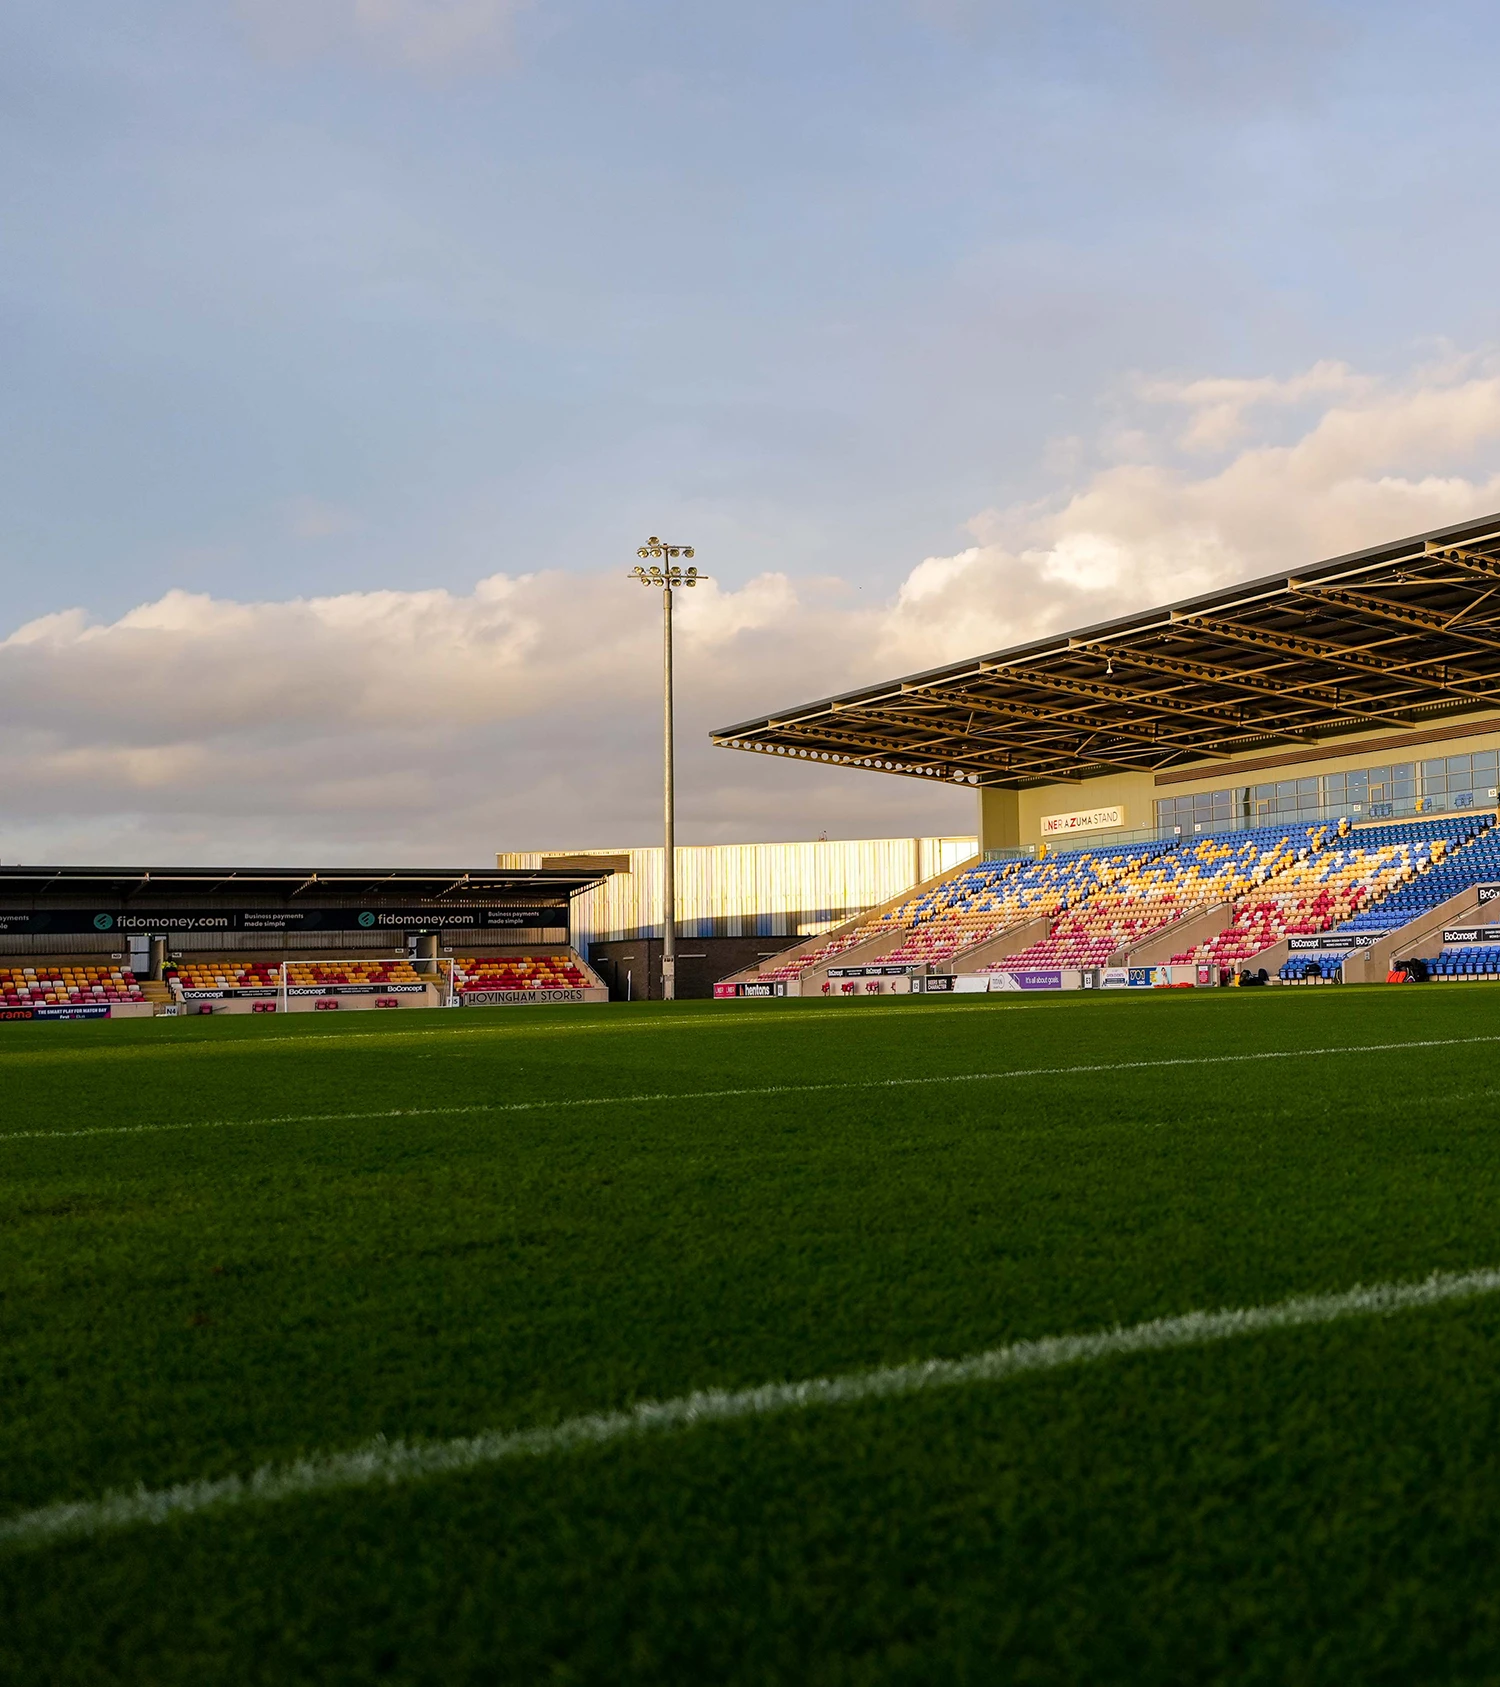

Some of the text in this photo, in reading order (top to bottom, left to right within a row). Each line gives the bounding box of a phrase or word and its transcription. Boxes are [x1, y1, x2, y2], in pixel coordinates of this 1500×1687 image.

[1043, 818, 1063, 831] LNER
[1093, 811, 1118, 824] STAND
[117, 915, 228, 929] fidomoney.com
[264, 920, 286, 928] simple
[378, 913, 474, 927] fidomoney.com
[1444, 931, 1478, 941] BoConcept
[1291, 939, 1319, 949] BoConcept
[387, 985, 423, 993] BoConcept
[745, 984, 770, 996] hentons
[468, 989, 583, 1003] HOVINGHAM STORES
[0, 1010, 32, 1019] rama
